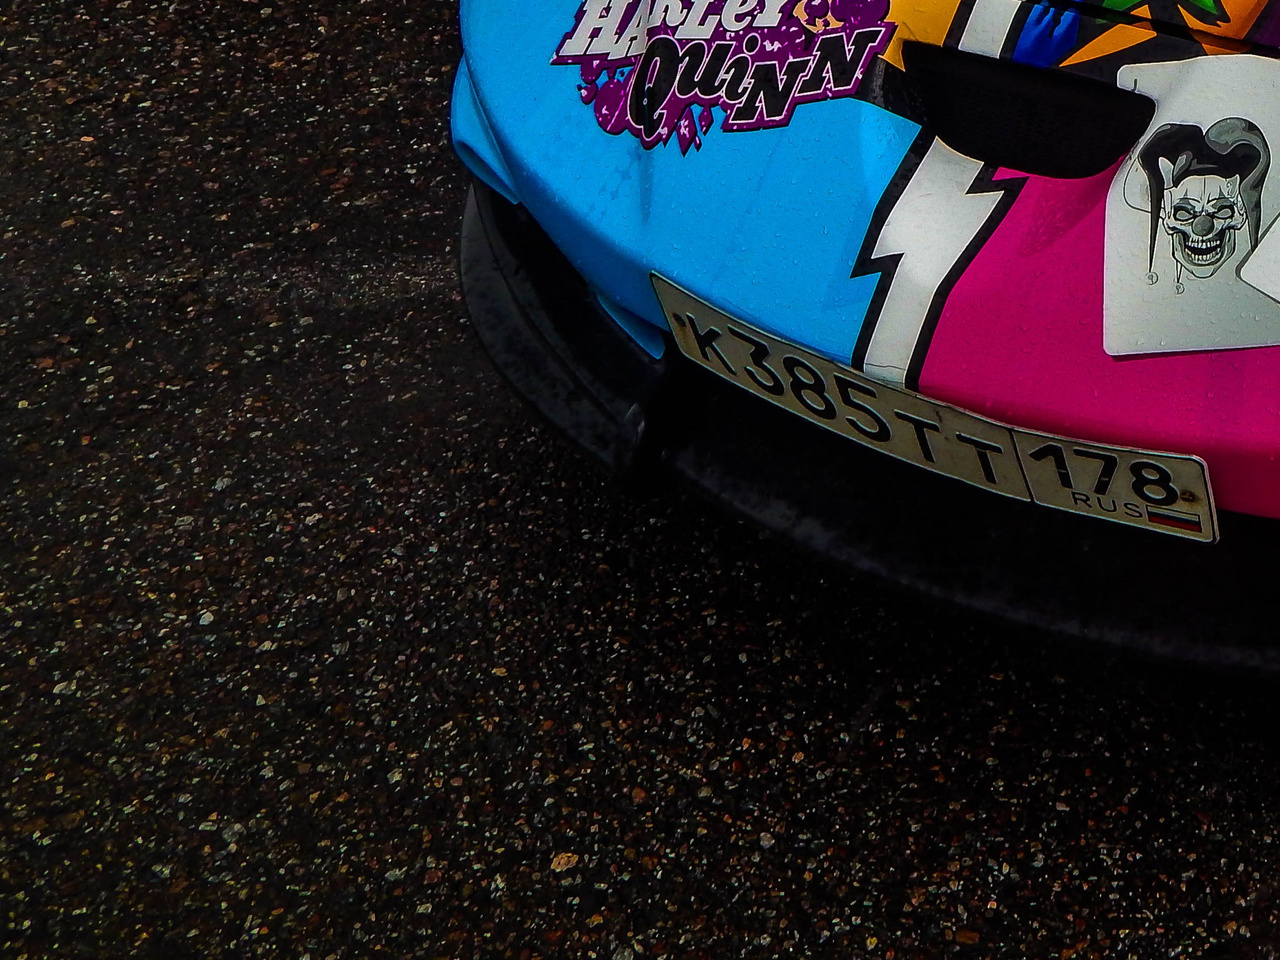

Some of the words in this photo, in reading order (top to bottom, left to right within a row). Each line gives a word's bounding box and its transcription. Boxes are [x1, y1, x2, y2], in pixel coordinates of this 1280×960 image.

[685, 312, 1003, 486] K385TT
[1028, 442, 1180, 507] 178
[1070, 489, 1146, 519] RUS
